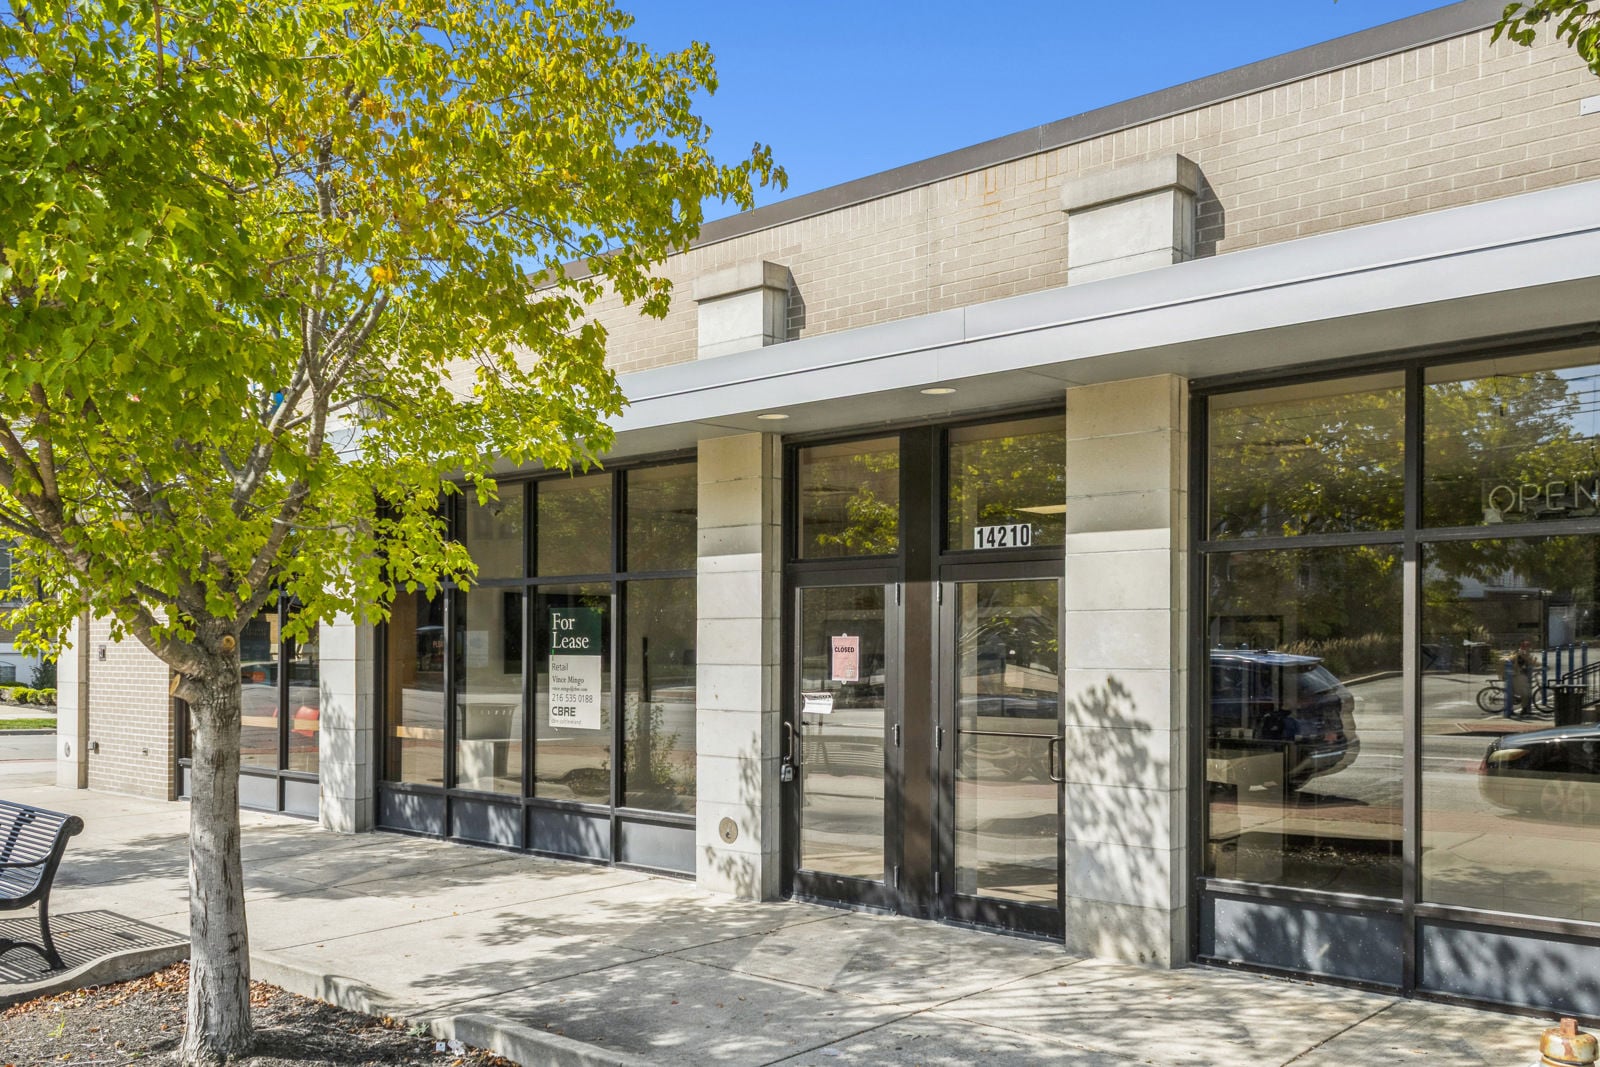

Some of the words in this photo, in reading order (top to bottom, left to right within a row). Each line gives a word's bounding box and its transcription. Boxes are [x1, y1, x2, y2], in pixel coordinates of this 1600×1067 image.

[1488, 478, 1600, 514] OPEN
[976, 524, 1030, 548] 14210
[552, 613, 576, 630] For
[552, 631, 590, 649] Lease
[551, 662, 569, 672] Retail
[551, 675, 567, 684] Vince
[567, 675, 585, 687] Mingo
[551, 693, 564, 702] 216
[565, 693, 577, 703] 535
[577, 694, 594, 704] 0188
[551, 706, 576, 717] CBRE
